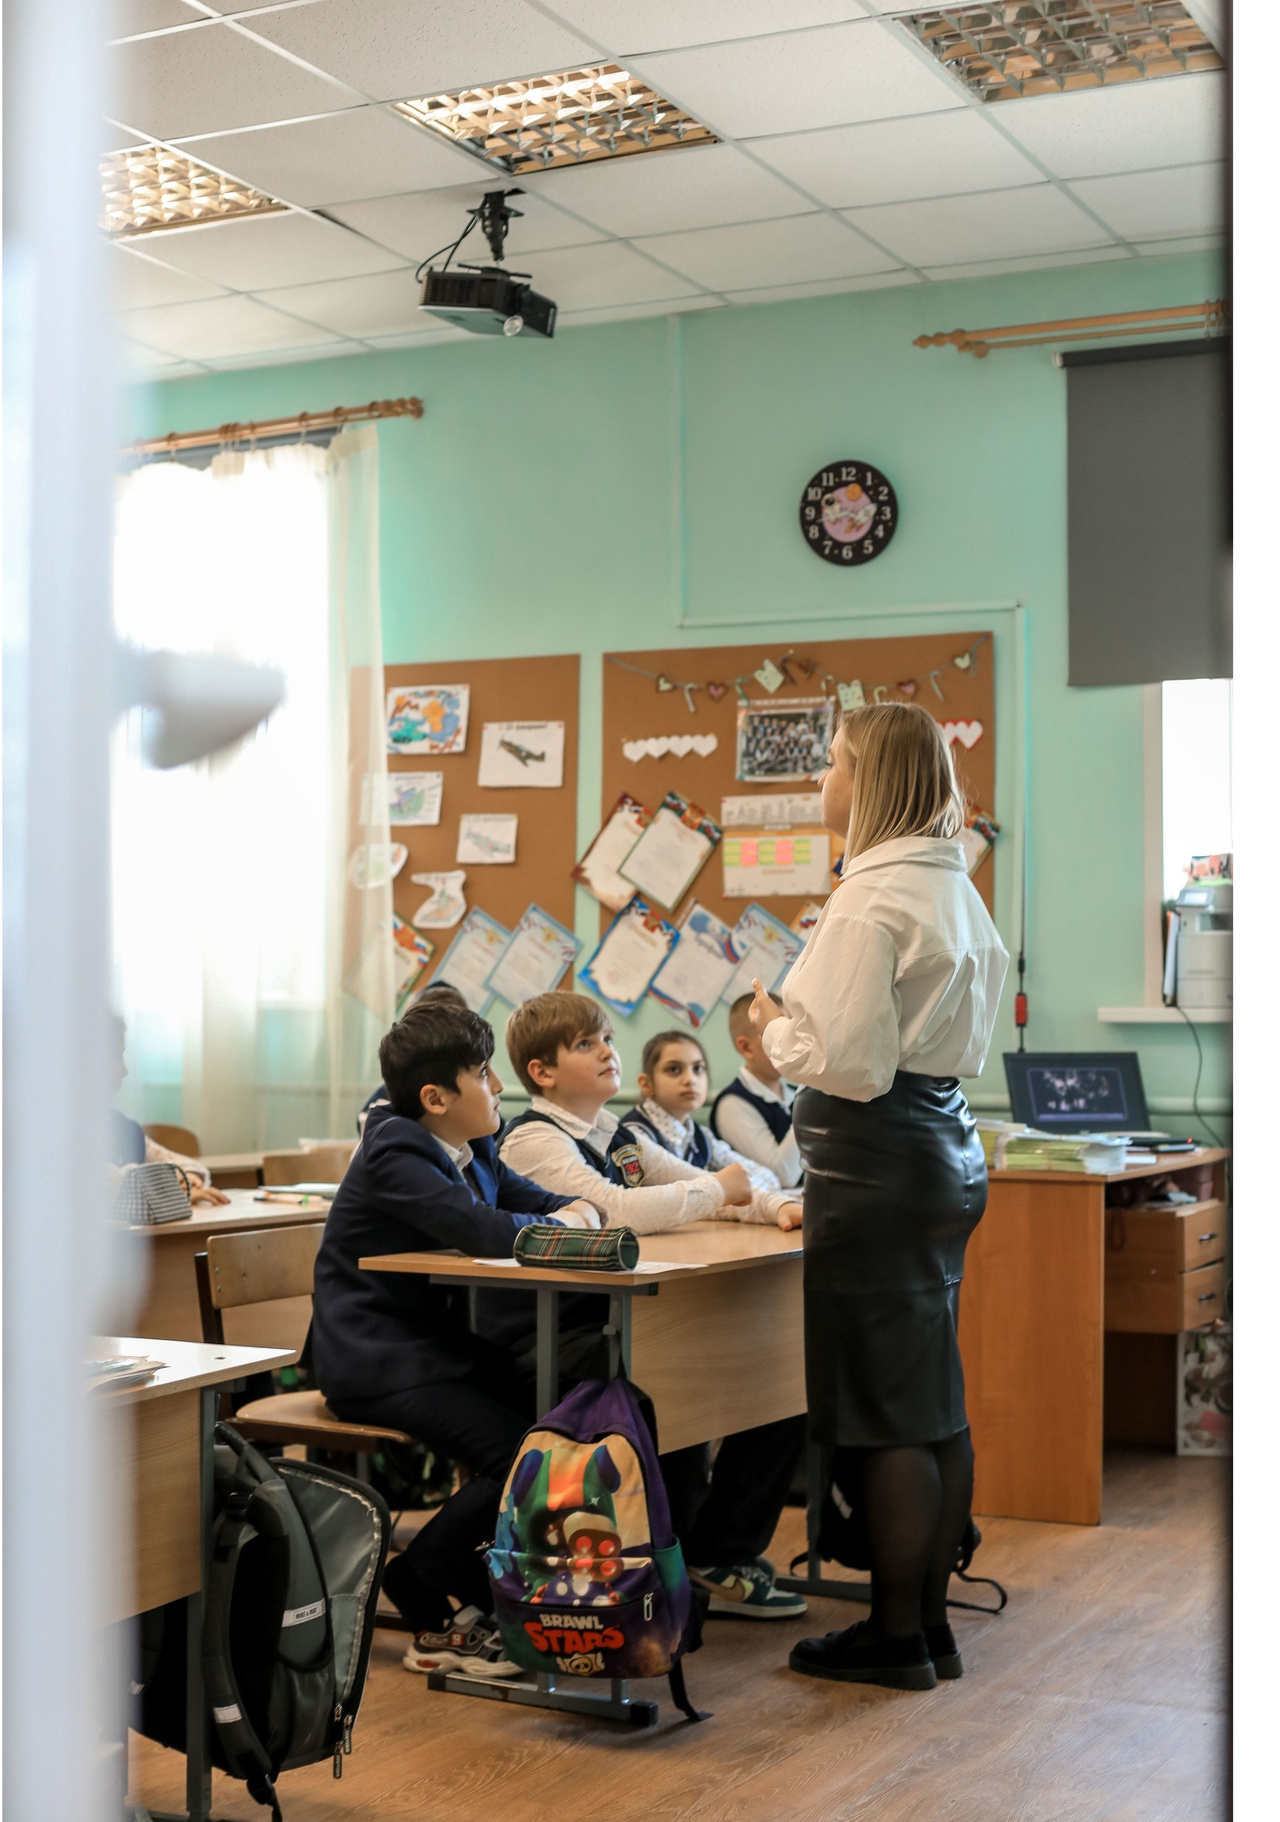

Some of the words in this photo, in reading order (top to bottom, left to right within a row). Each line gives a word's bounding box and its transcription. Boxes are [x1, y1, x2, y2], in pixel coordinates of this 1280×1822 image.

[822, 472, 834, 486] 11
[841, 467, 857, 481] 12
[865, 471, 872, 486] 1
[807, 487, 822, 501] 10
[878, 486, 889, 500] 2
[805, 506, 816, 520] 9
[880, 506, 891, 520] 3
[808, 525, 819, 539] 8
[874, 524, 884, 538] 4
[822, 540, 833, 555] 7
[842, 545, 853, 560] 6
[863, 540, 874, 554] 5
[539, 1613, 604, 1630] BRAWL
[523, 1621, 625, 1655] STARS
